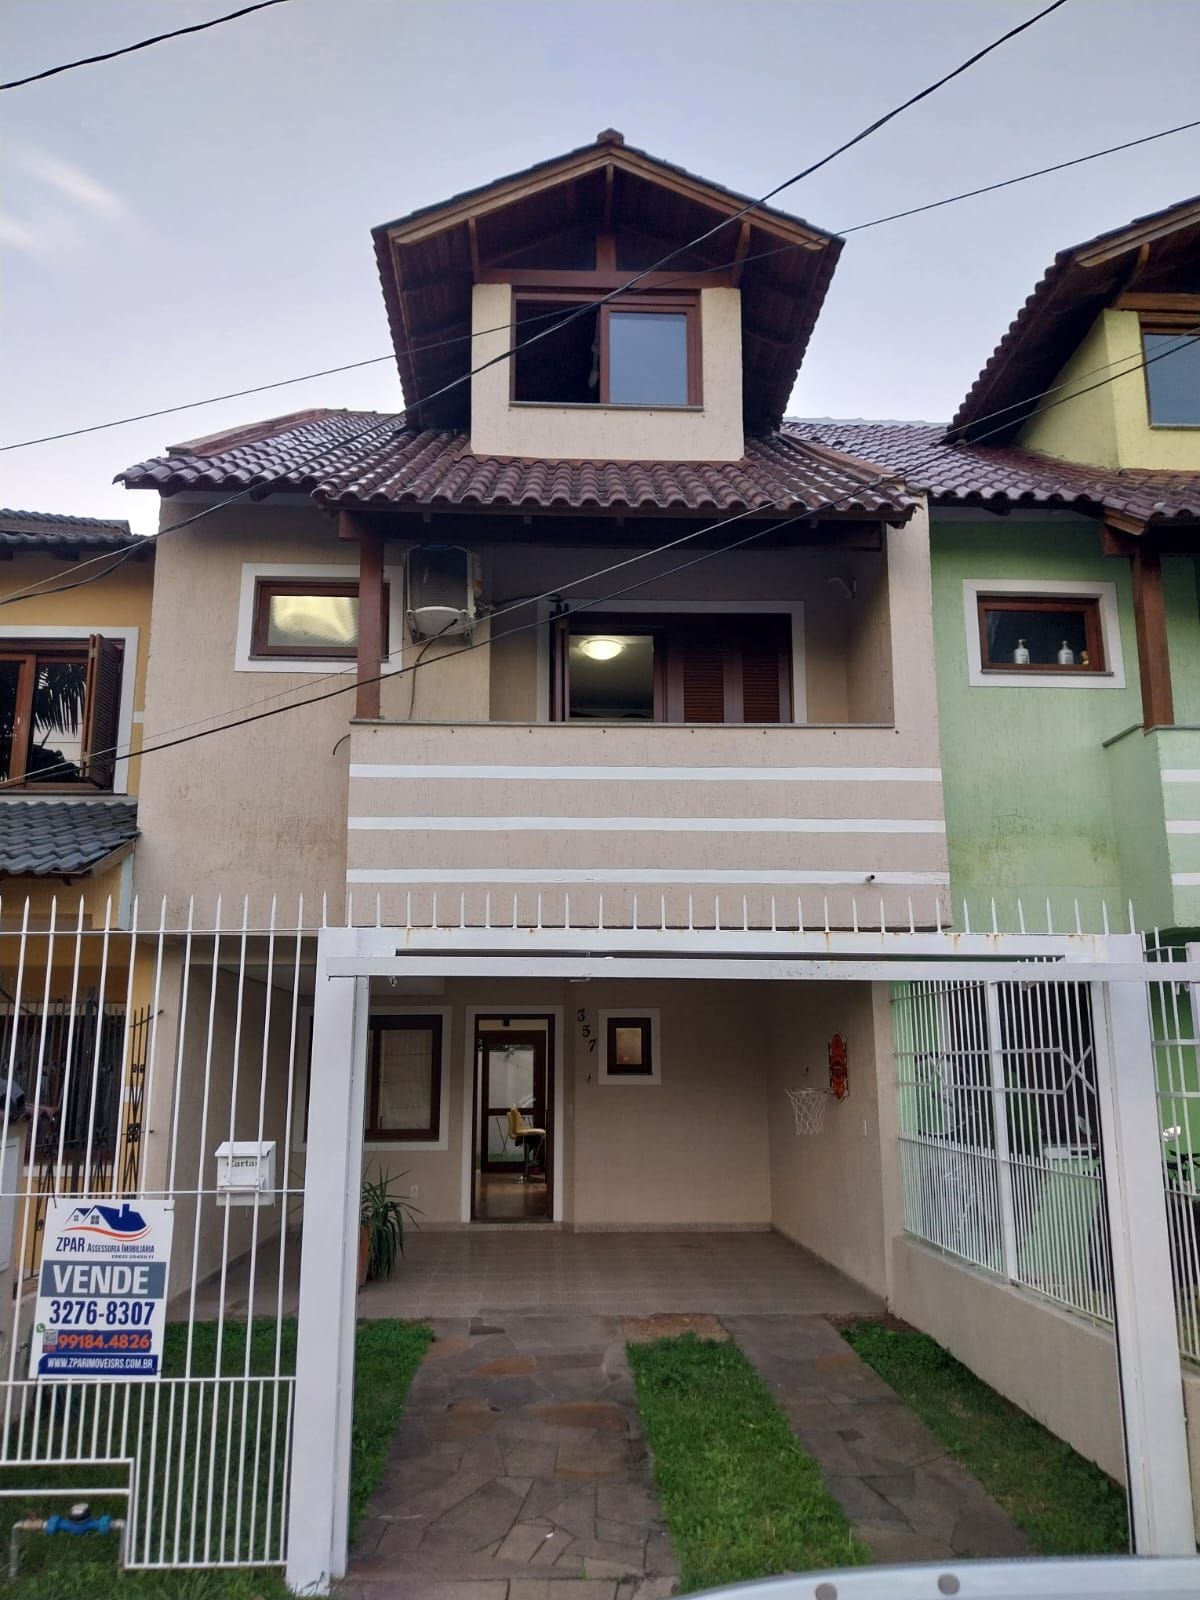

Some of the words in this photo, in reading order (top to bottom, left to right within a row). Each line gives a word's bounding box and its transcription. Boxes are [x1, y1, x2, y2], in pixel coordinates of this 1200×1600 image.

[576, 1008, 597, 1052] 357
[56, 1237, 85, 1252] ZPAR
[53, 1265, 149, 1294] VENDE
[49, 1301, 155, 1325] 3276-8307
[58, 1334, 150, 1349] 99184.4826
